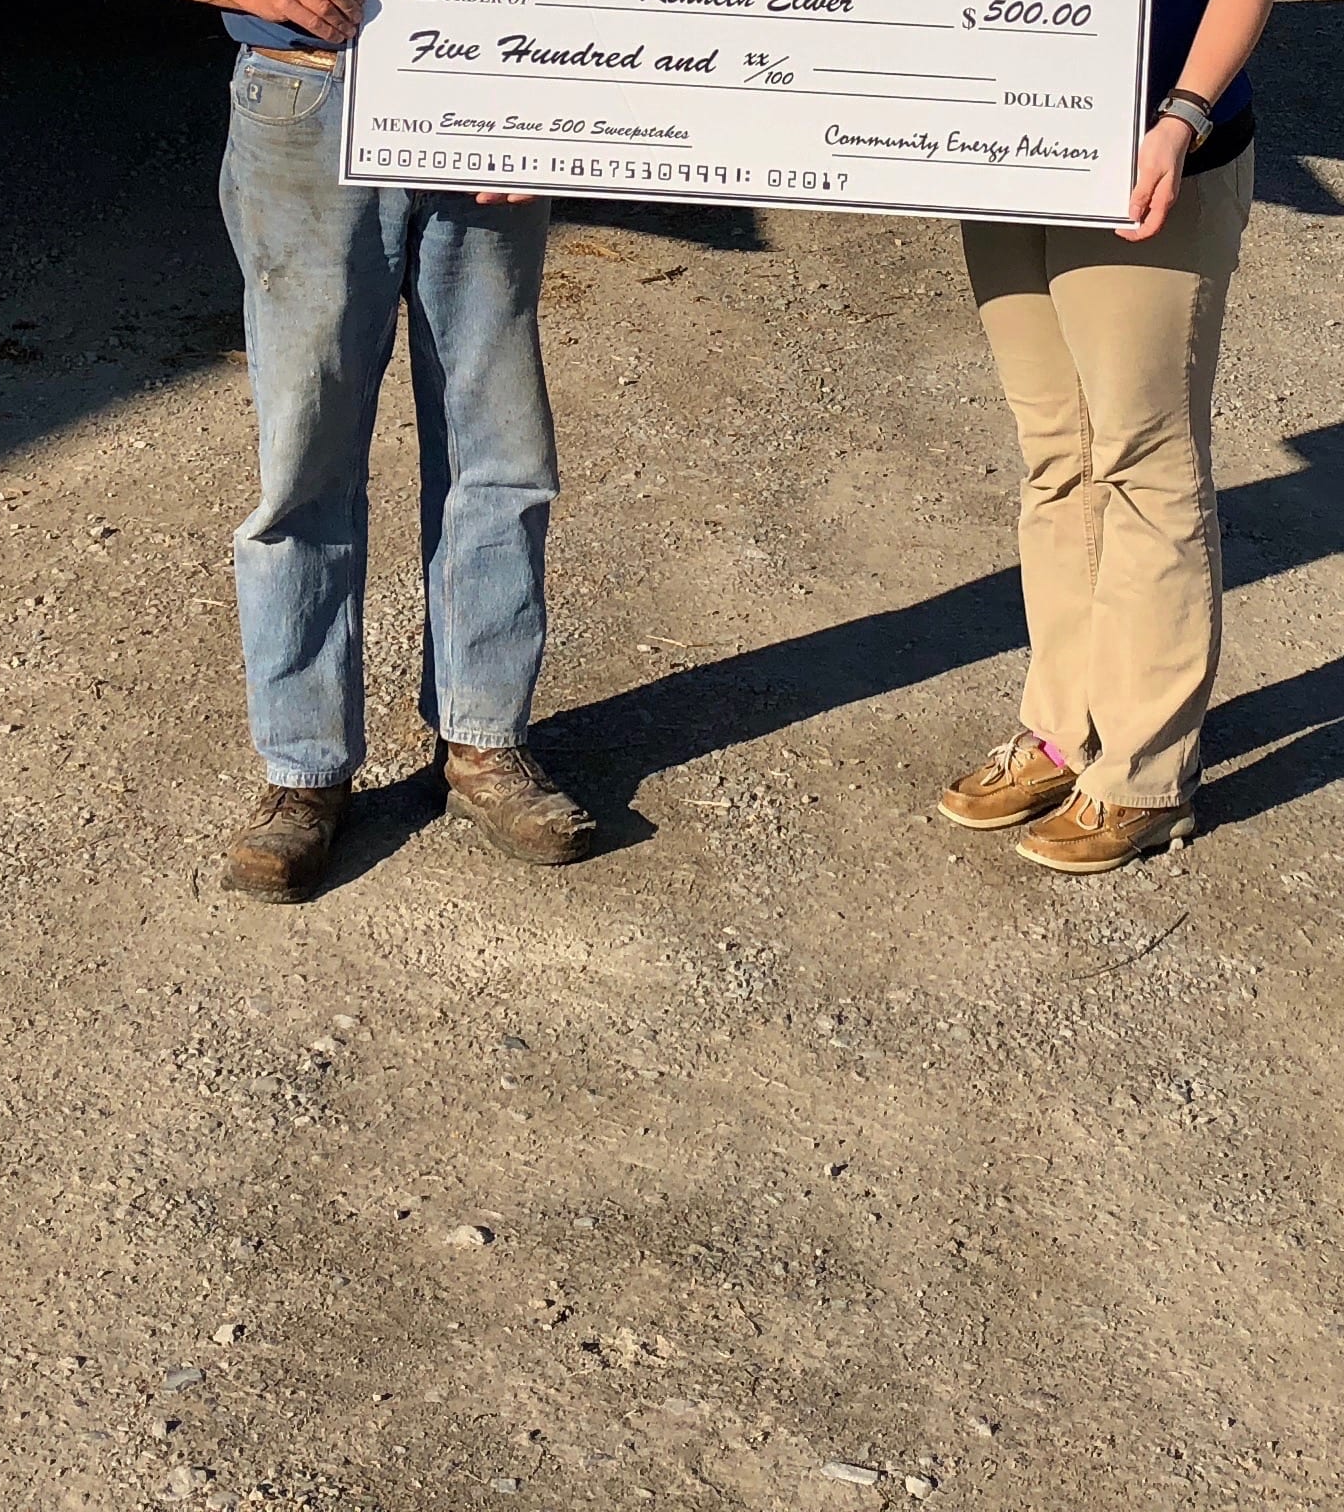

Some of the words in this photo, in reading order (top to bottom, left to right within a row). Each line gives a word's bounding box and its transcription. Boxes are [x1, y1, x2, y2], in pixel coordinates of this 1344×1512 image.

[408, 30, 481, 65] Five
[496, 34, 646, 71] Hundred
[654, 49, 718, 75] and
[1003, 92, 1094, 110] DOLLARS
[371, 117, 433, 134] MEMO
[439, 113, 496, 133] Energy
[502, 116, 543, 132] Save
[549, 119, 585, 134] 500
[590, 120, 691, 140] Sweepstakes
[824, 124, 939, 157] Community
[946, 131, 1010, 162] Energy
[1015, 135, 1099, 161] Advisors
